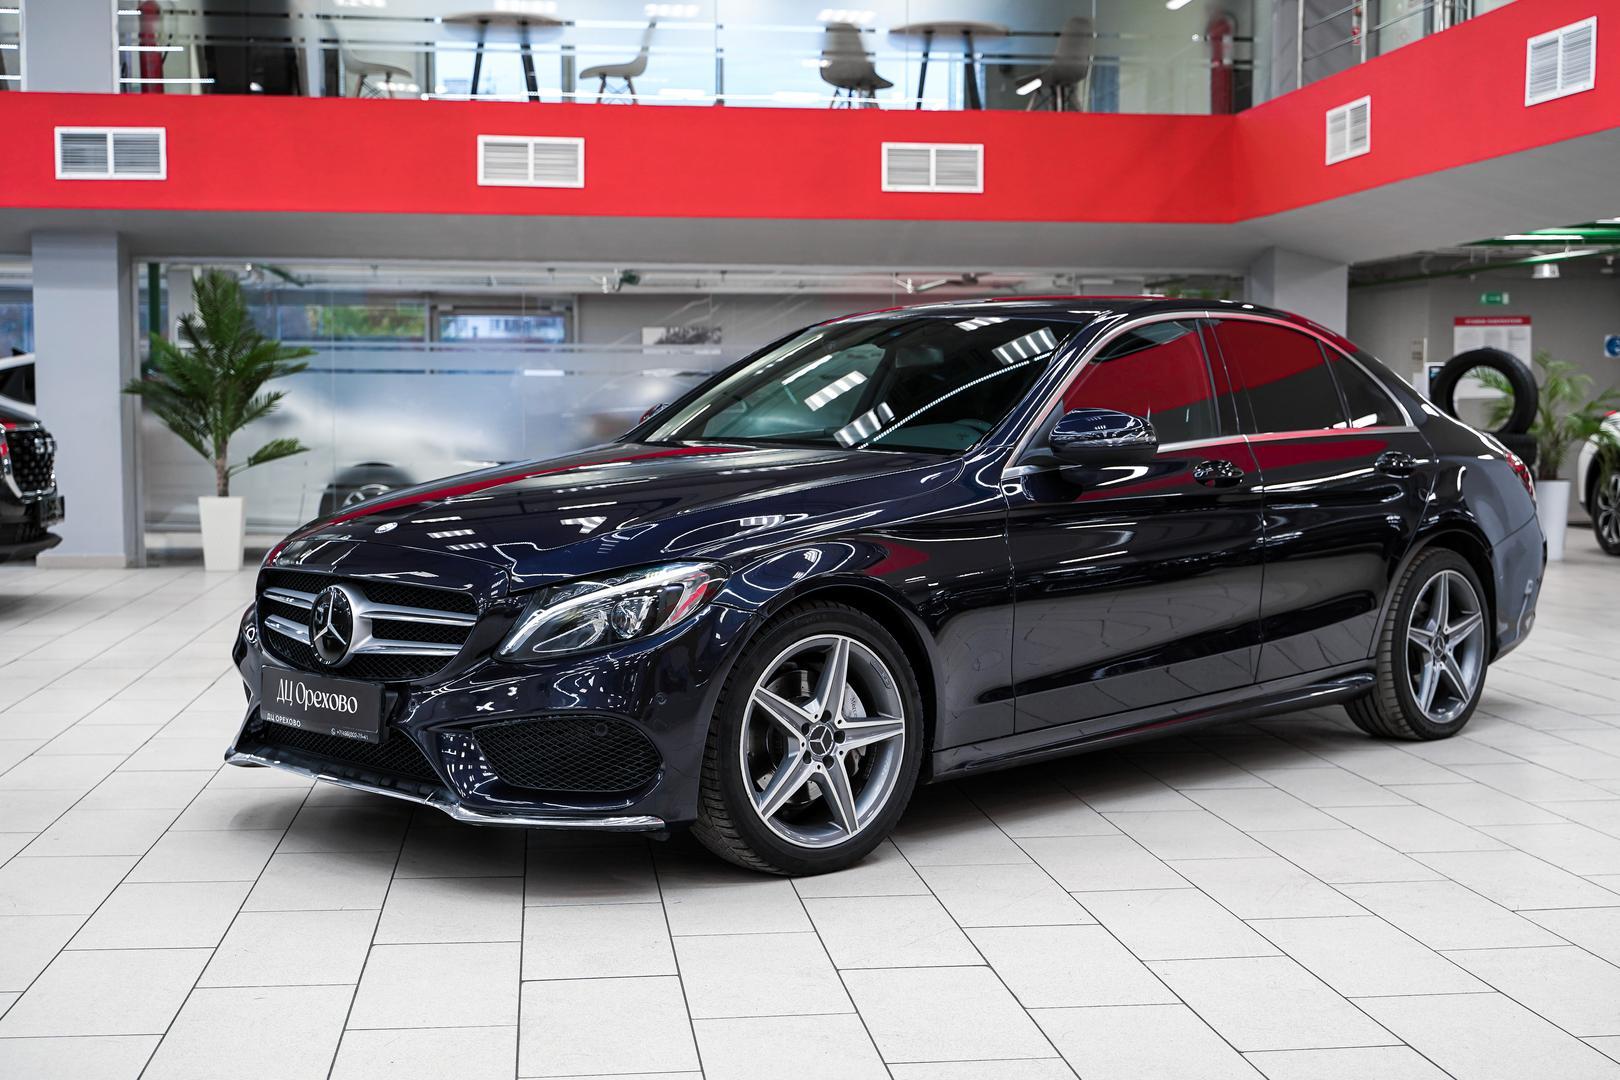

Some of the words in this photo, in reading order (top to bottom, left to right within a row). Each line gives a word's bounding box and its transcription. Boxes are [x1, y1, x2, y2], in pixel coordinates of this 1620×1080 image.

[276, 678, 293, 706] ДЦ
[295, 681, 358, 714] Орехово
[275, 714, 301, 727] ОРЕХОВО
